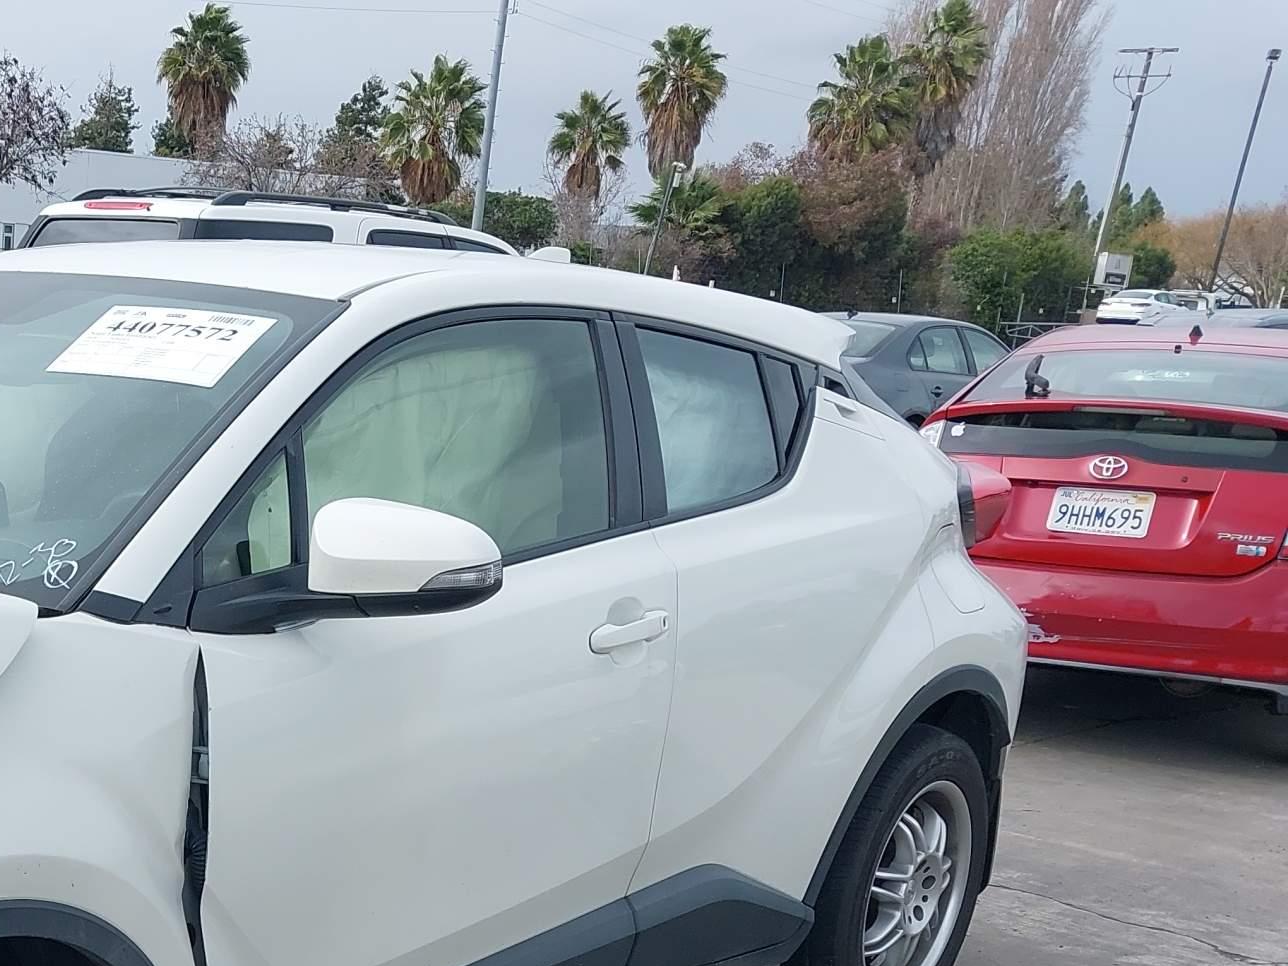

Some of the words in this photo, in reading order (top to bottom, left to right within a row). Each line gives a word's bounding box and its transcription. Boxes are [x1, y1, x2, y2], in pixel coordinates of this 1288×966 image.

[106, 320, 238, 342] 44077572
[1075, 490, 1136, 505] California
[1054, 504, 1144, 530] 9HHM695
[1217, 532, 1276, 544] PRIUS
